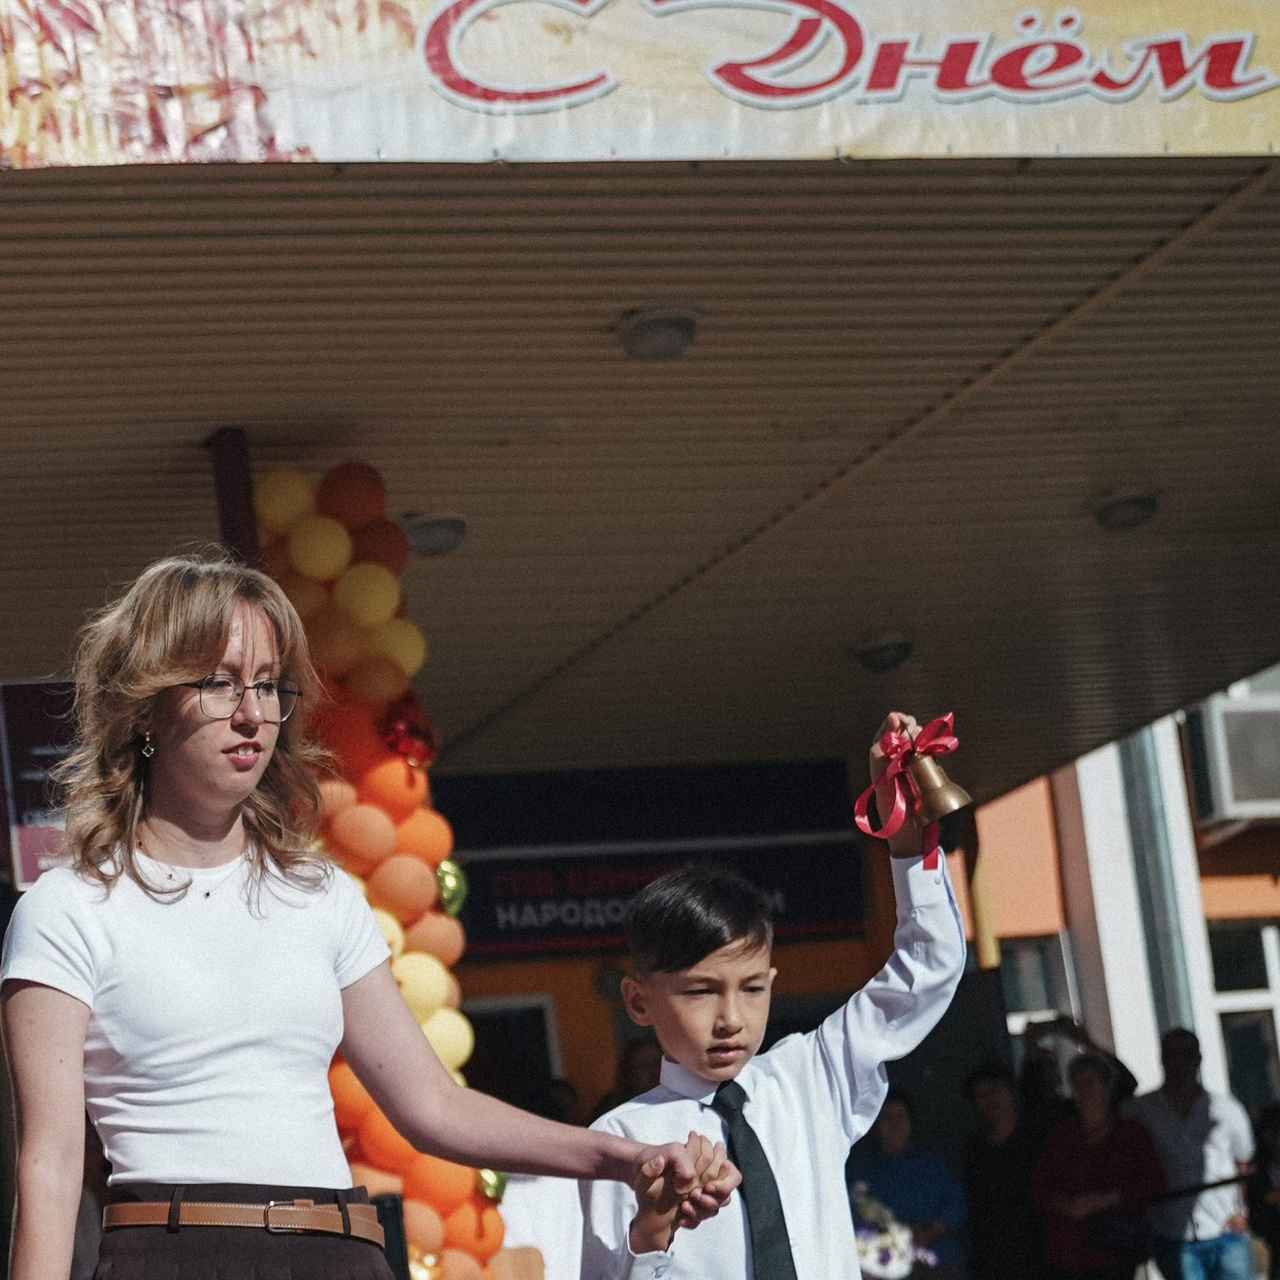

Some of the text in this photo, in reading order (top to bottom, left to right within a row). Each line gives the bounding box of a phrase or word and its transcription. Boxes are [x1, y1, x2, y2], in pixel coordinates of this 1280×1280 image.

[422, 0, 1270, 101] С Днём
[494, 899, 628, 929] НАРОДО
